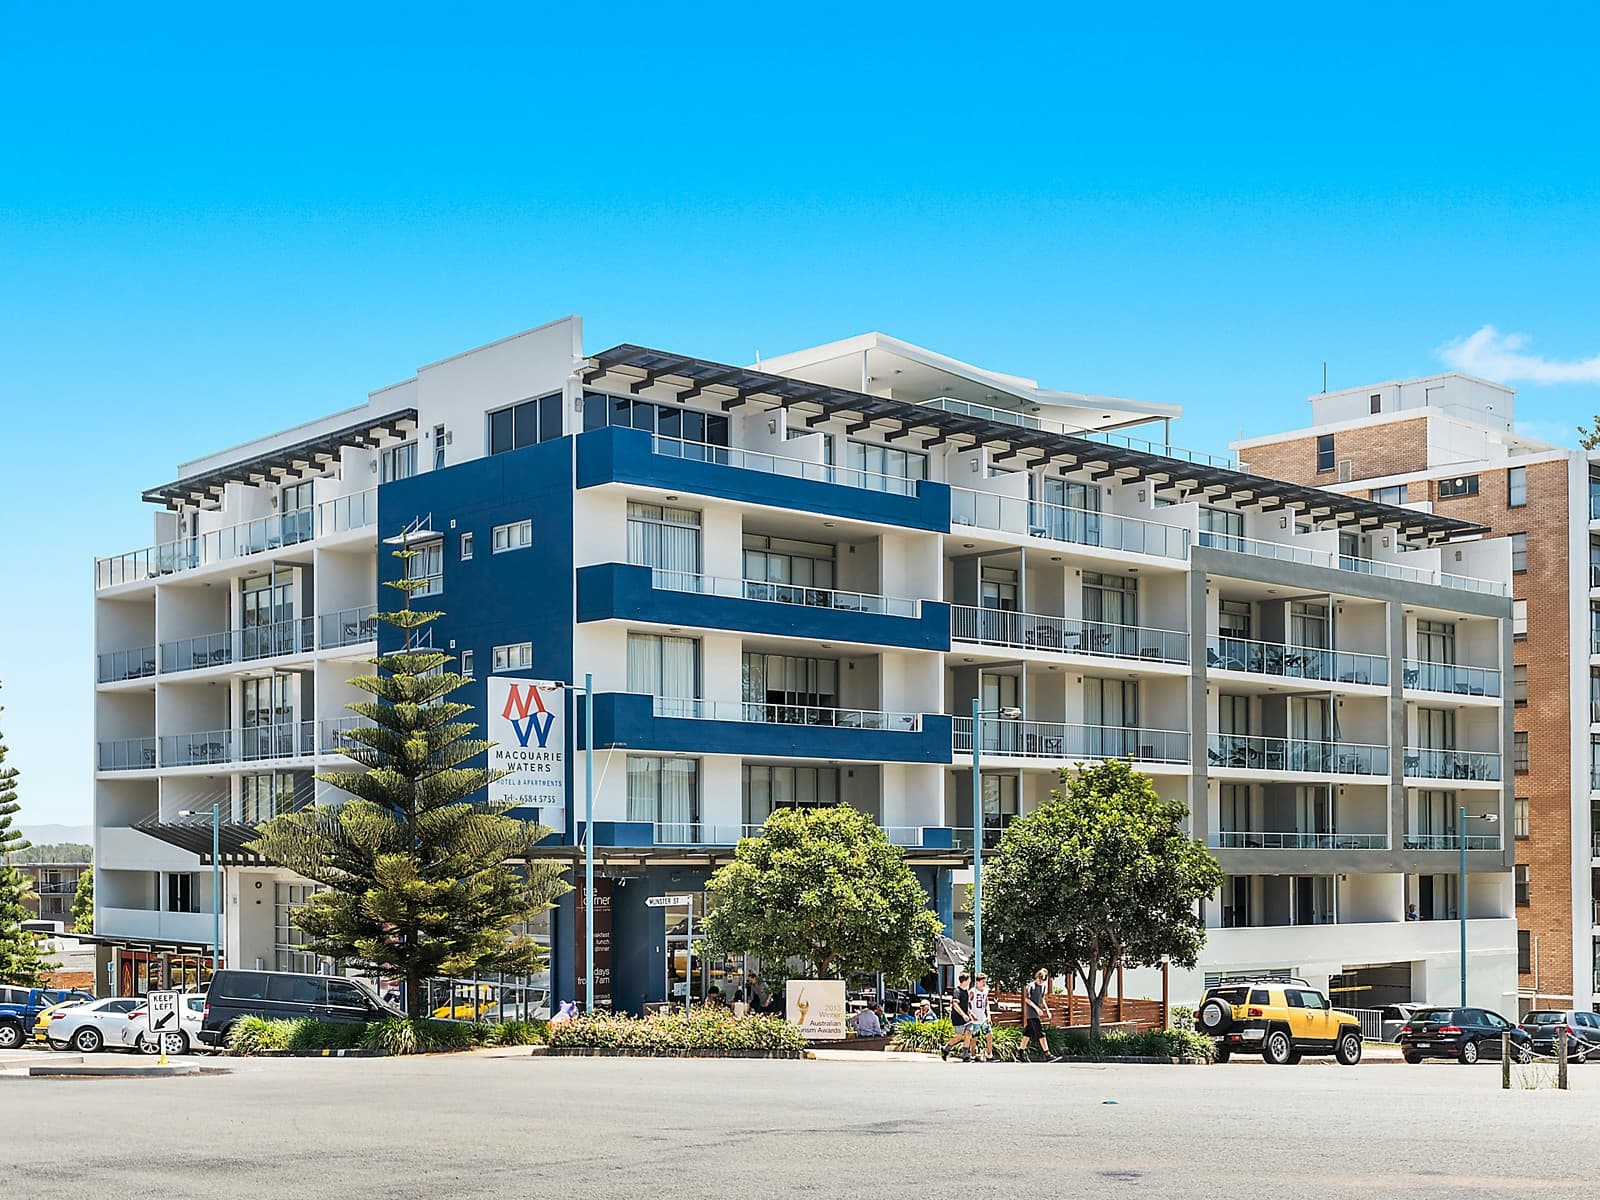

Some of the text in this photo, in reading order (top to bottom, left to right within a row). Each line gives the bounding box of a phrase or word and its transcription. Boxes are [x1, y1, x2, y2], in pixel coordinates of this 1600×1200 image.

[496, 750, 562, 762] MACQUARIE
[507, 762, 551, 772] WATERS
[523, 779, 562, 787] APARTMENTS
[519, 794, 538, 803] 6584
[539, 795, 557, 804] 5755
[583, 887, 598, 897] te
[583, 896, 611, 906] crner
[649, 897, 680, 905] MUNSTER ST
[595, 976, 610, 985] 7am
[153, 994, 174, 1002] KEEP
[154, 1003, 173, 1011] LEFT
[810, 1019, 842, 1027] Australian
